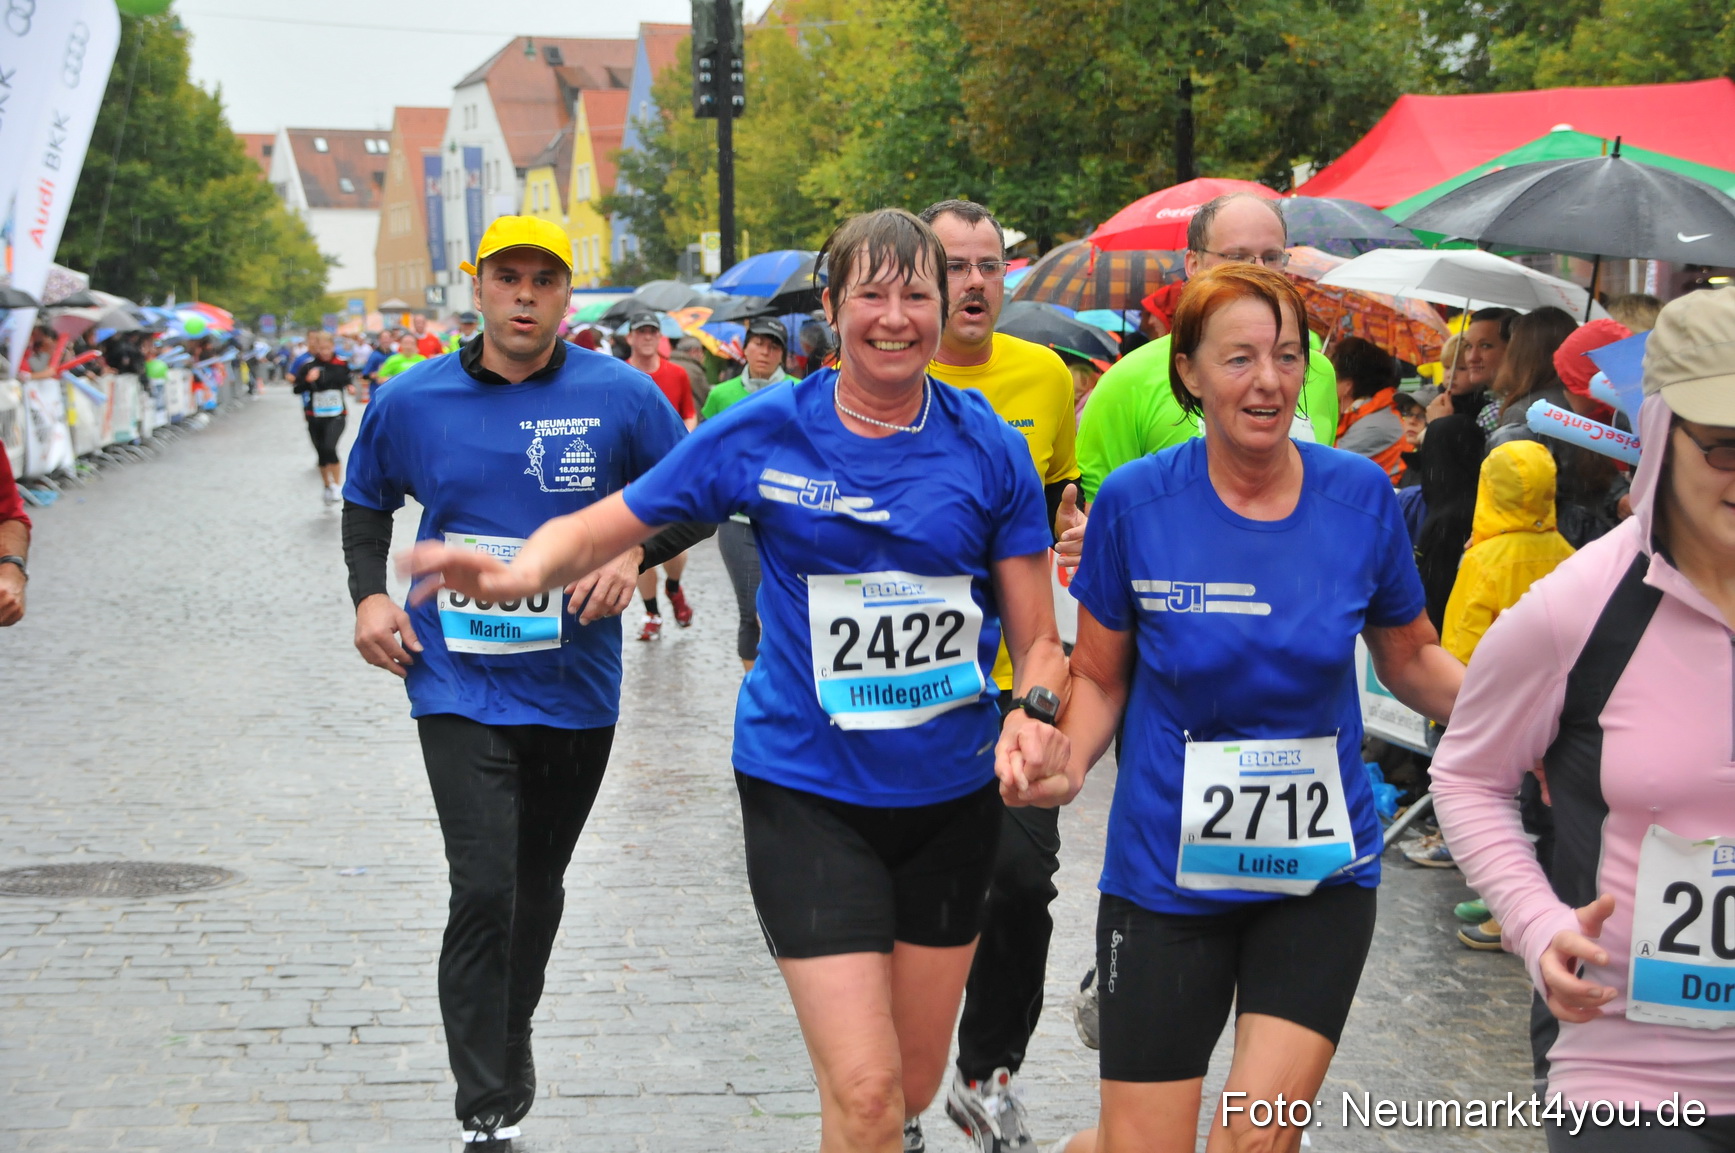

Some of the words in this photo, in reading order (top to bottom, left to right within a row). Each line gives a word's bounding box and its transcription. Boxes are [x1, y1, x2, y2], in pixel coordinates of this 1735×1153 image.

[28, 176, 55, 249] Audi
[42, 108, 70, 171] BKK
[519, 420, 536, 430] 12.
[536, 417, 601, 429] NEUMARKTER
[534, 426, 589, 437] STADTLAUF
[1543, 408, 1643, 455] eiseCenter
[862, 582, 926, 598] BOCK
[470, 619, 521, 639] Martin
[829, 610, 966, 672] 2422
[850, 675, 953, 708] Hildegard
[1239, 750, 1301, 767] BOCK
[1201, 781, 1335, 840] 2712
[1238, 853, 1299, 875] Luise
